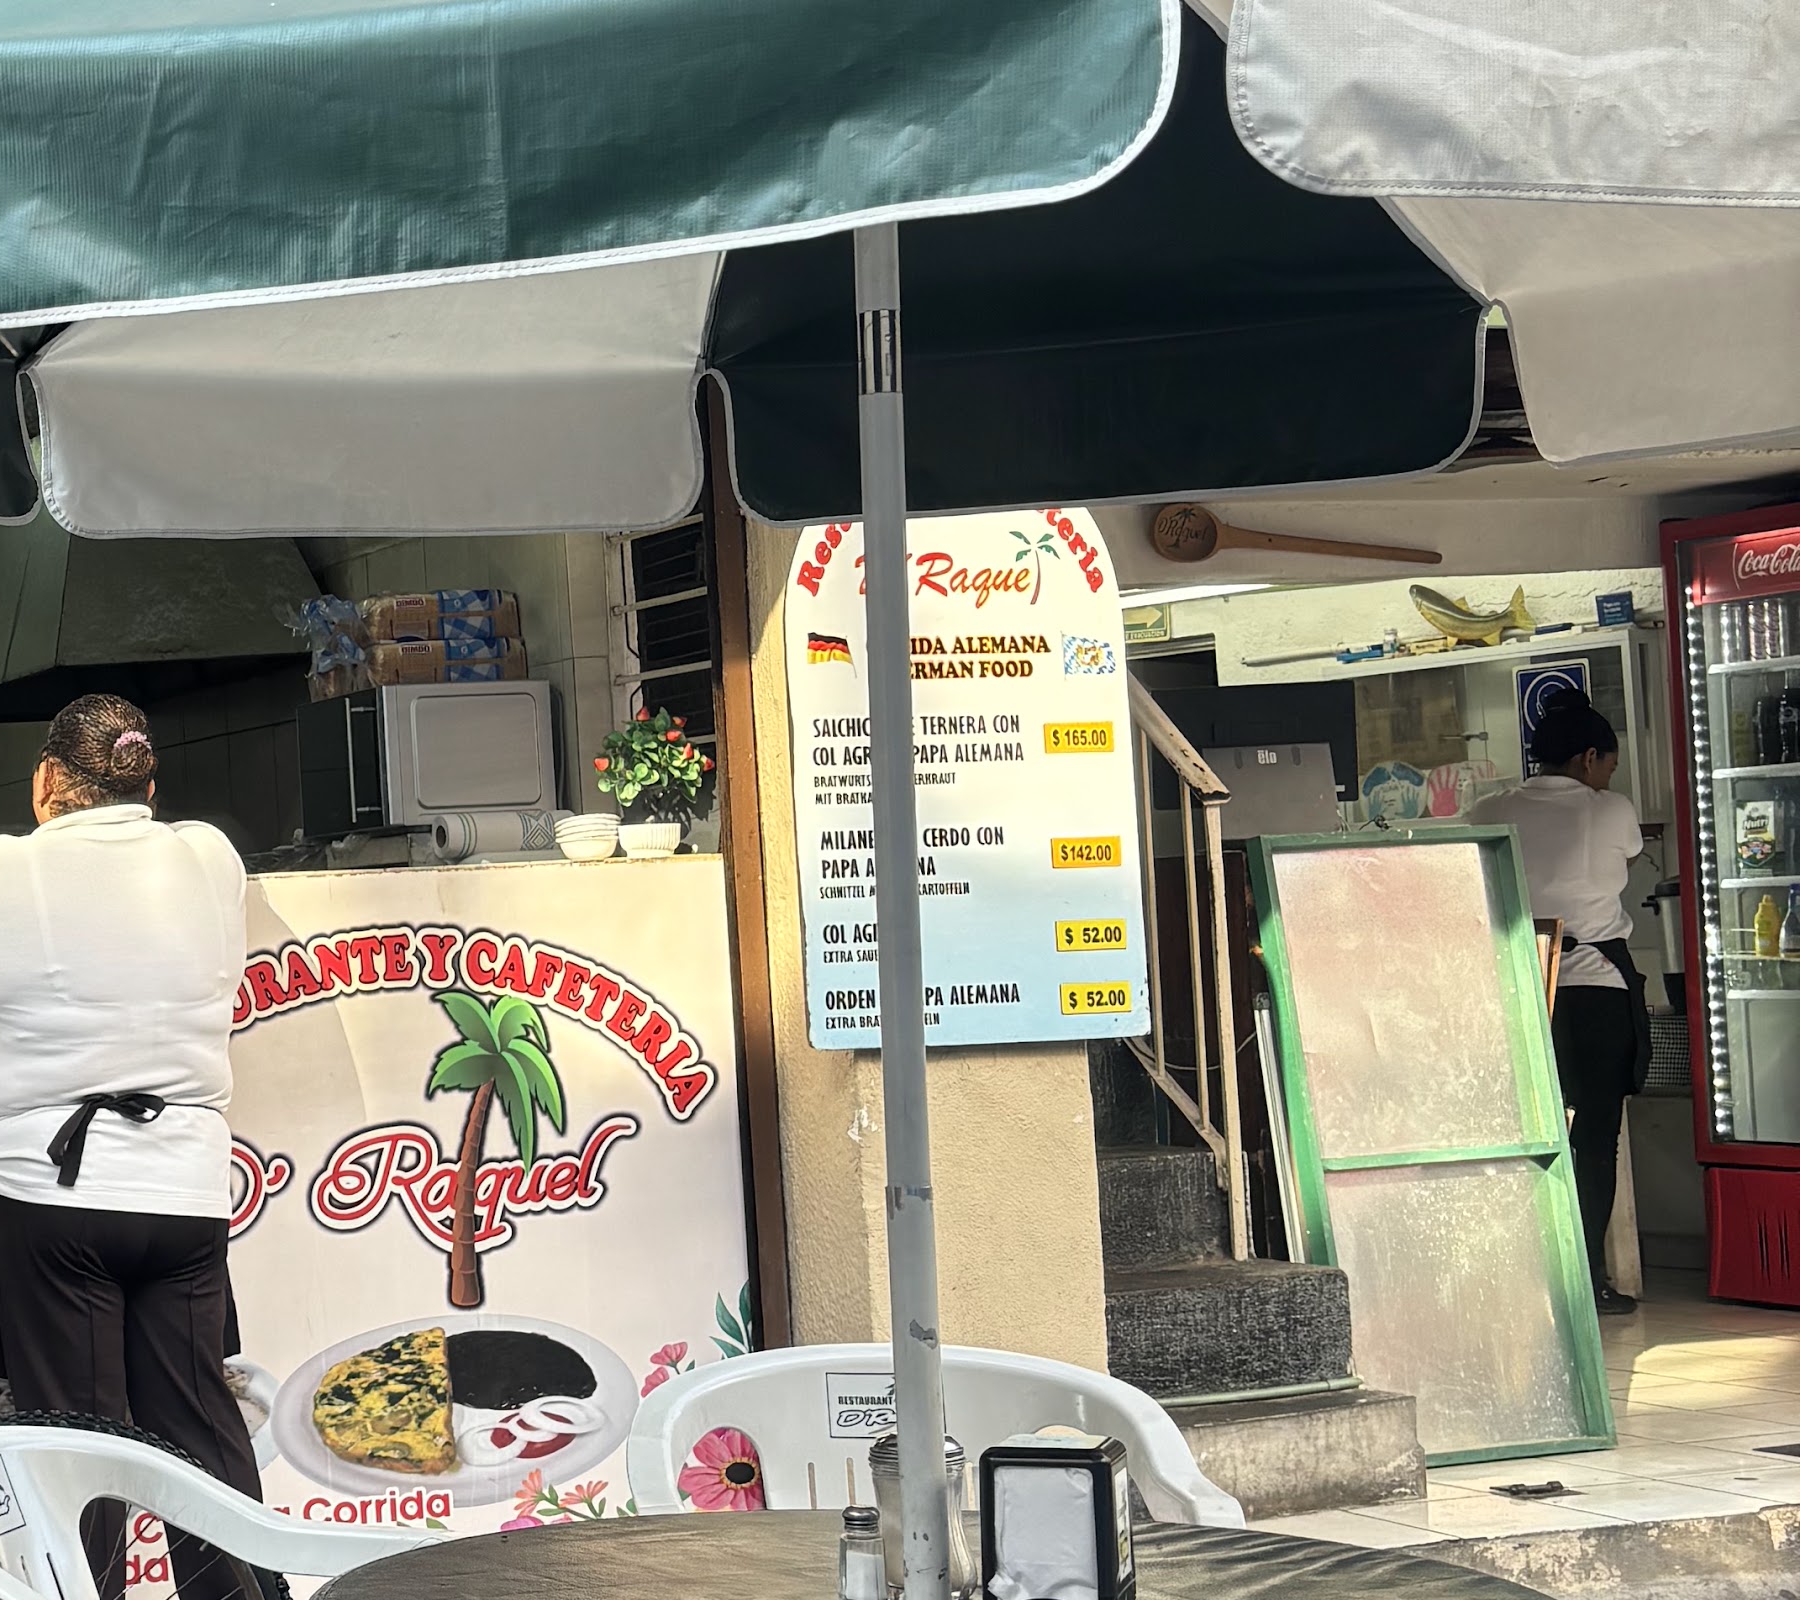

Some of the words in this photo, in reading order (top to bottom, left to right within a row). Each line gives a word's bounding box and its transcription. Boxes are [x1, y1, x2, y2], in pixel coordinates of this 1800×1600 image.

[950, 635, 1051, 655] ALEMANA
[978, 659, 1034, 679] FOOD
[812, 718, 871, 739] SALCHIC
[920, 715, 987, 736] TERNERA
[992, 714, 1021, 734] CON
[1051, 730, 1061, 747] $
[1064, 729, 1108, 747] 165.00
[812, 747, 838, 766] COL
[954, 742, 1025, 763] ALEMANA
[815, 794, 833, 805] MIT
[922, 827, 971, 848] CERDO
[976, 826, 1004, 846] CON
[821, 859, 860, 879] PAPA
[819, 885, 866, 900] SCHNITZEL
[823, 924, 848, 944] COL
[1065, 927, 1074, 946] $
[1082, 926, 1122, 943] 52.00
[823, 950, 853, 963] EXTRA
[825, 989, 876, 1011] ORDEN
[950, 983, 1021, 1006] ALEMANA
[1068, 992, 1078, 1009] $
[1086, 989, 1126, 1007] 52.00
[416, 934, 457, 981] Y
[465, 939, 709, 1114] CAFETERIA
[825, 1016, 856, 1030] EXTRA
[317, 1120, 633, 1243] Raquel
[302, 1490, 451, 1524] Corrida
